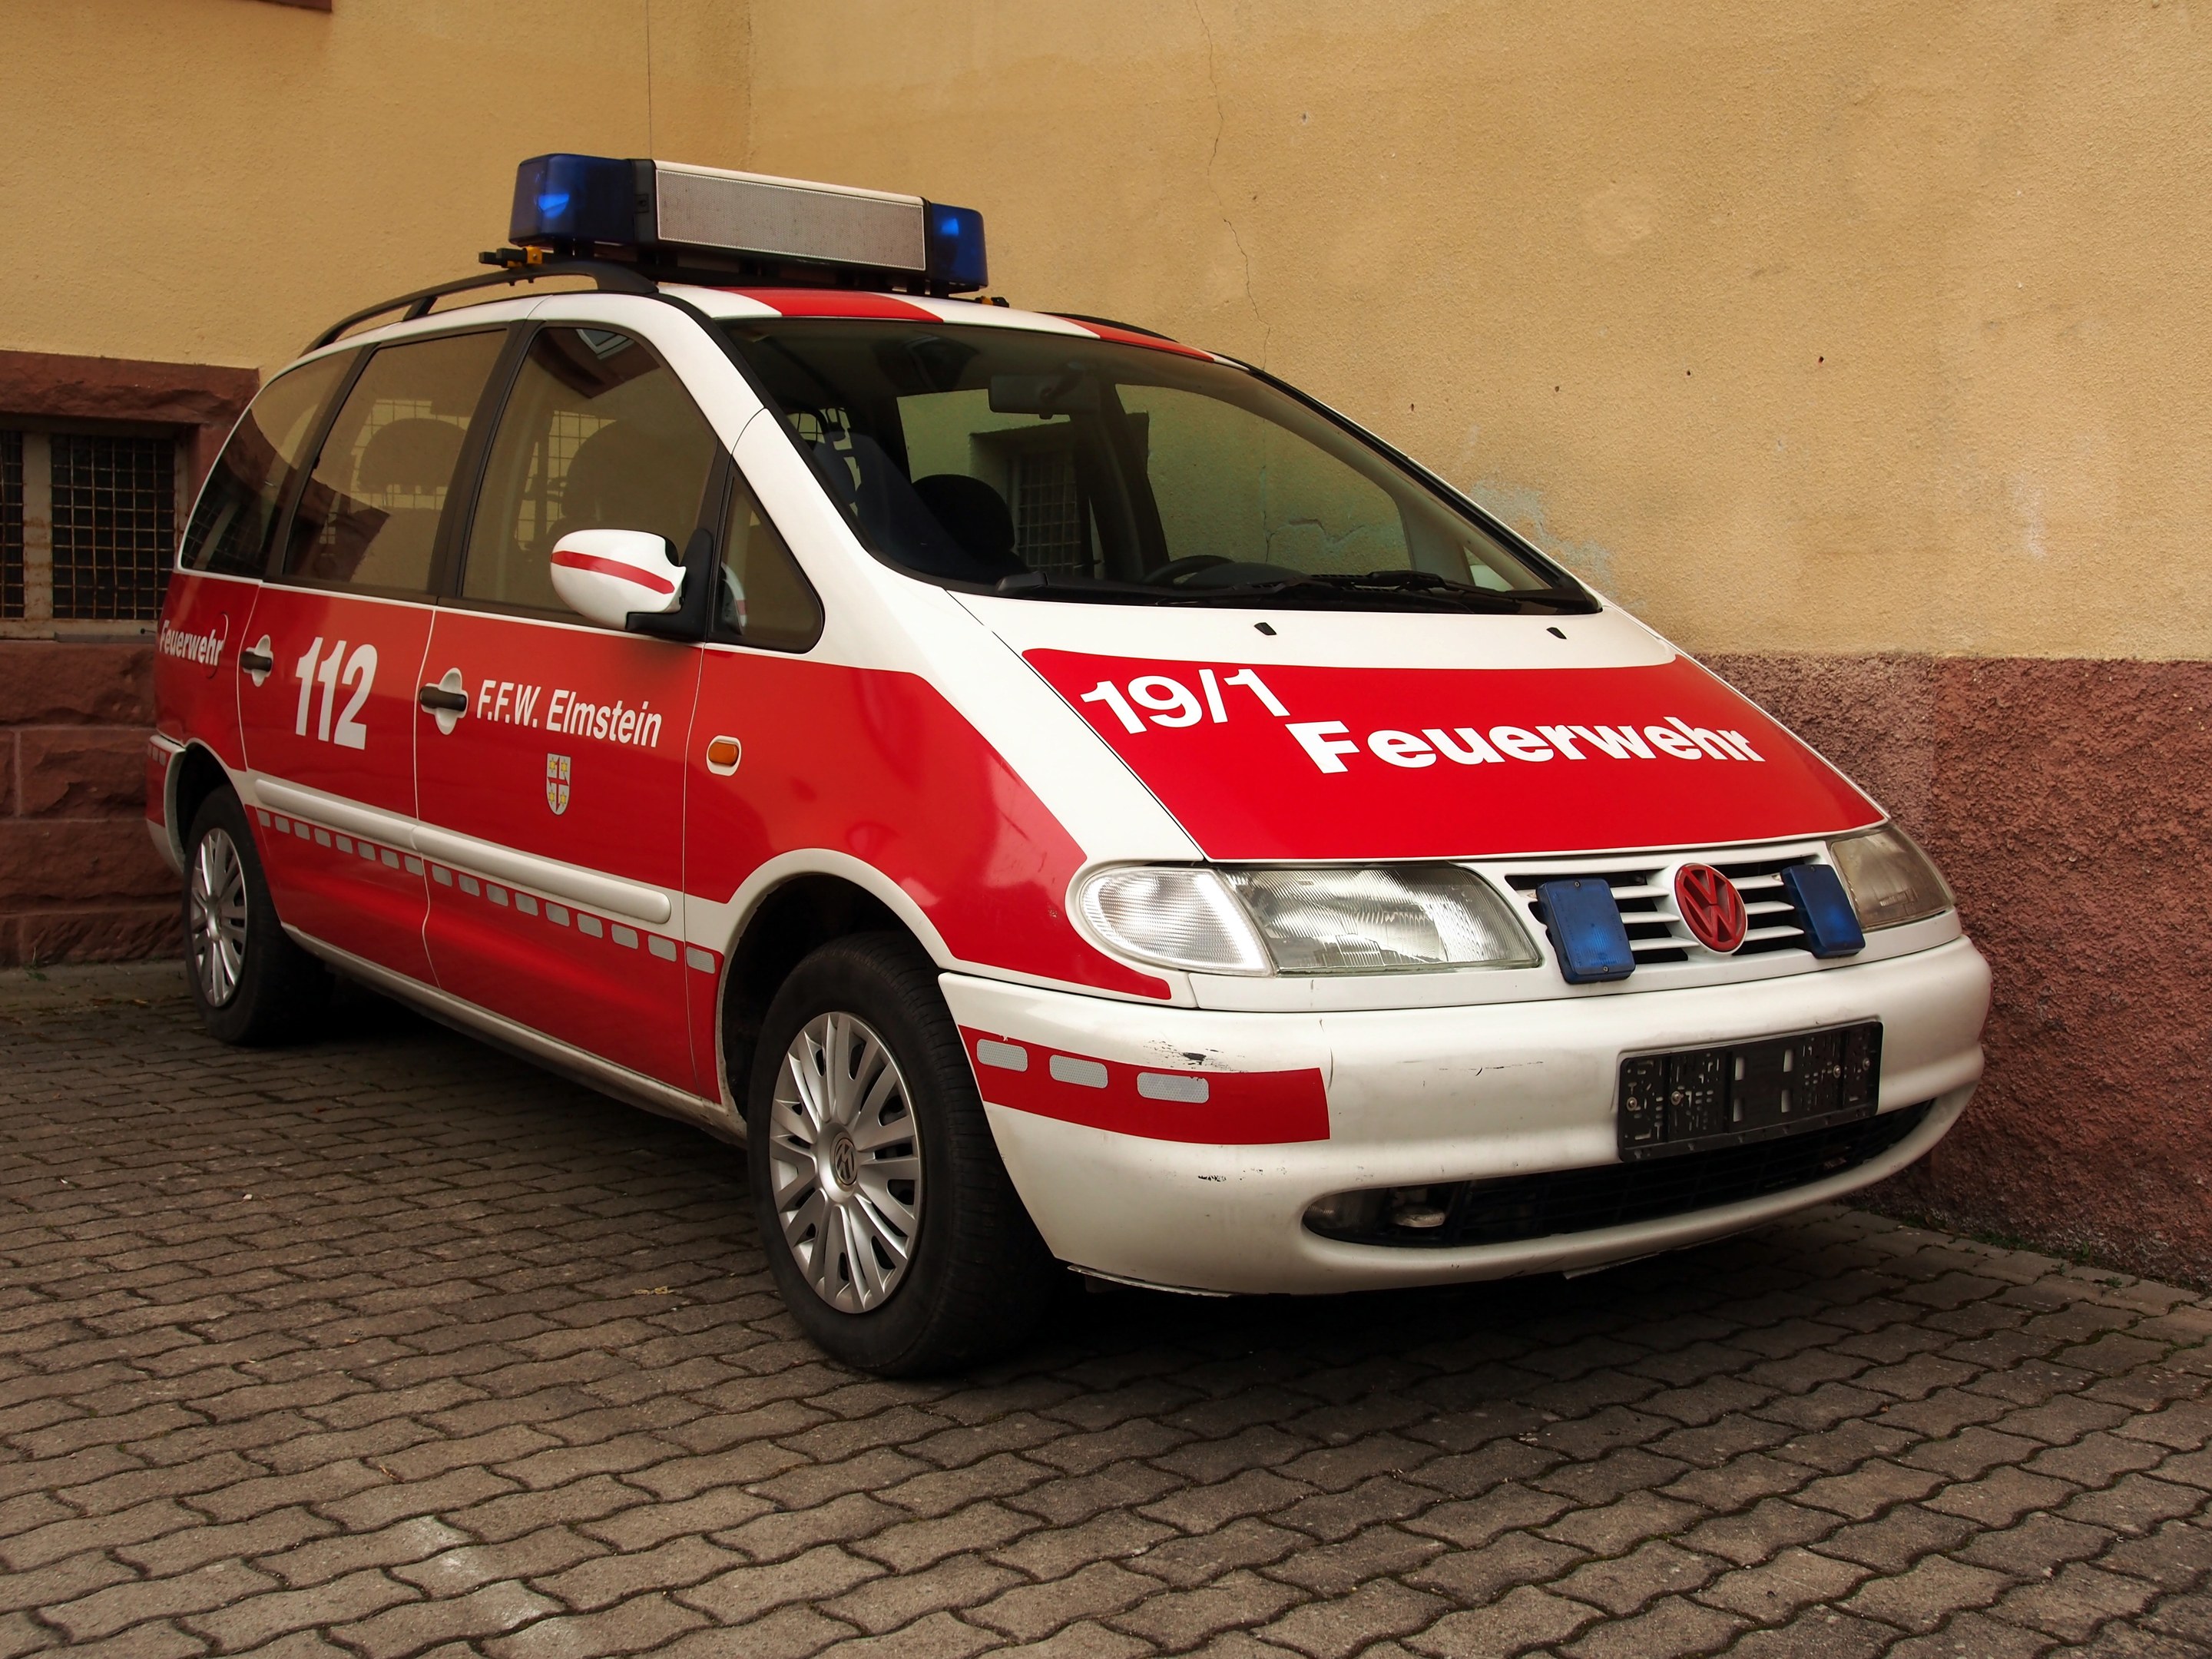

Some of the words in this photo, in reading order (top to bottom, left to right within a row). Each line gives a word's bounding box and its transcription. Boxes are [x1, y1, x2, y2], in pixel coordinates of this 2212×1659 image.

[159, 619, 225, 667] Feuerwehr
[295, 637, 378, 750] 112
[476, 679, 542, 729] F.F.W.
[546, 688, 663, 748] Elmstein
[1080, 668, 1290, 734] 19/1
[1284, 716, 1766, 774] Feuerwehr
[1675, 863, 1747, 952] VW
